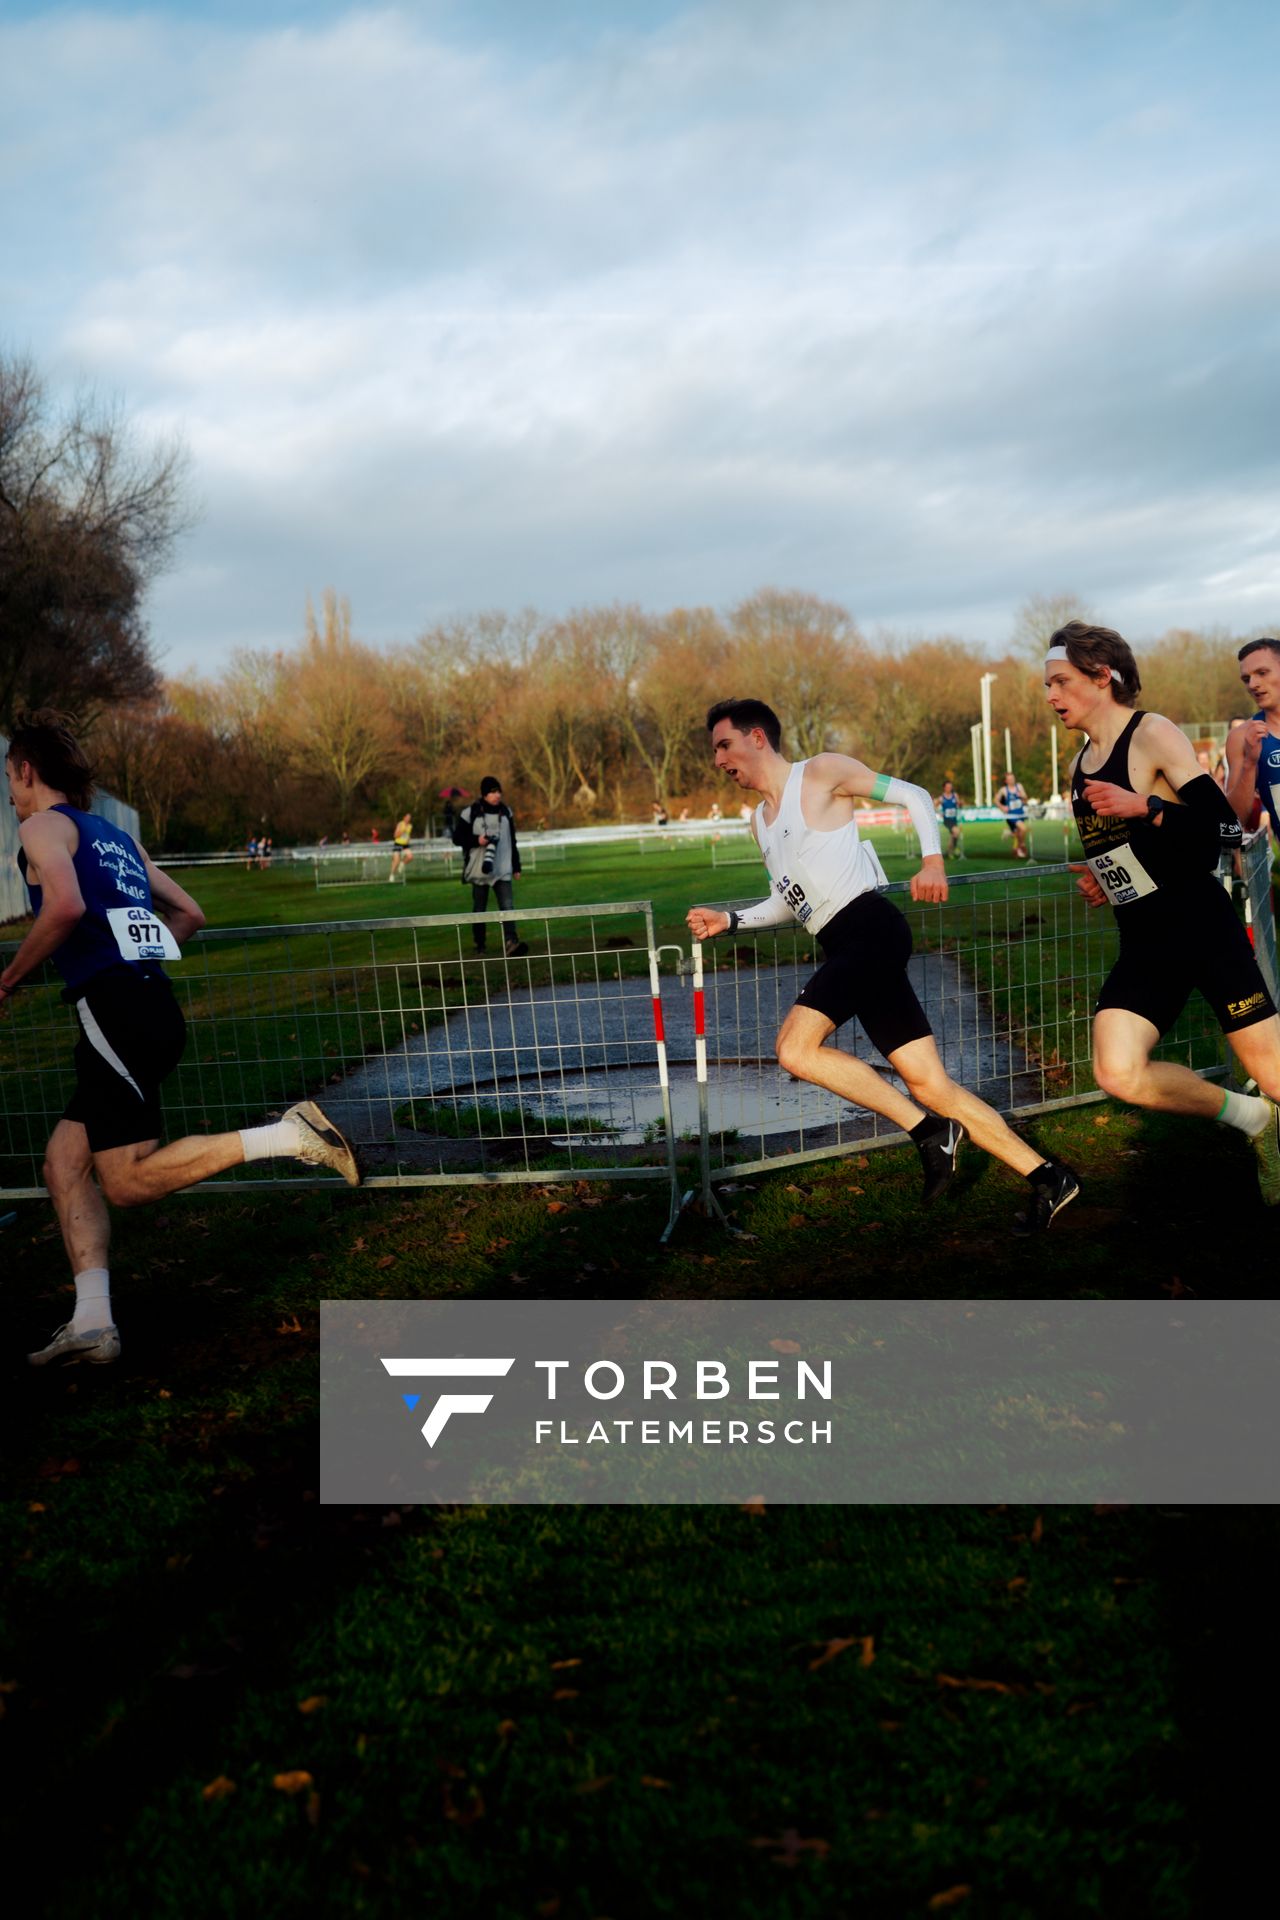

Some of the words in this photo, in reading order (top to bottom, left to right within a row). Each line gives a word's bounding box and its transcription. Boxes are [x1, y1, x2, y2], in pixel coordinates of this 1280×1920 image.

[1095, 856, 1114, 869] GLS
[1101, 866, 1131, 890] 290
[116, 879, 146, 900] Halle
[1121, 887, 1136, 899] PLAN
[127, 910, 151, 920] GLS
[128, 924, 161, 943] 977
